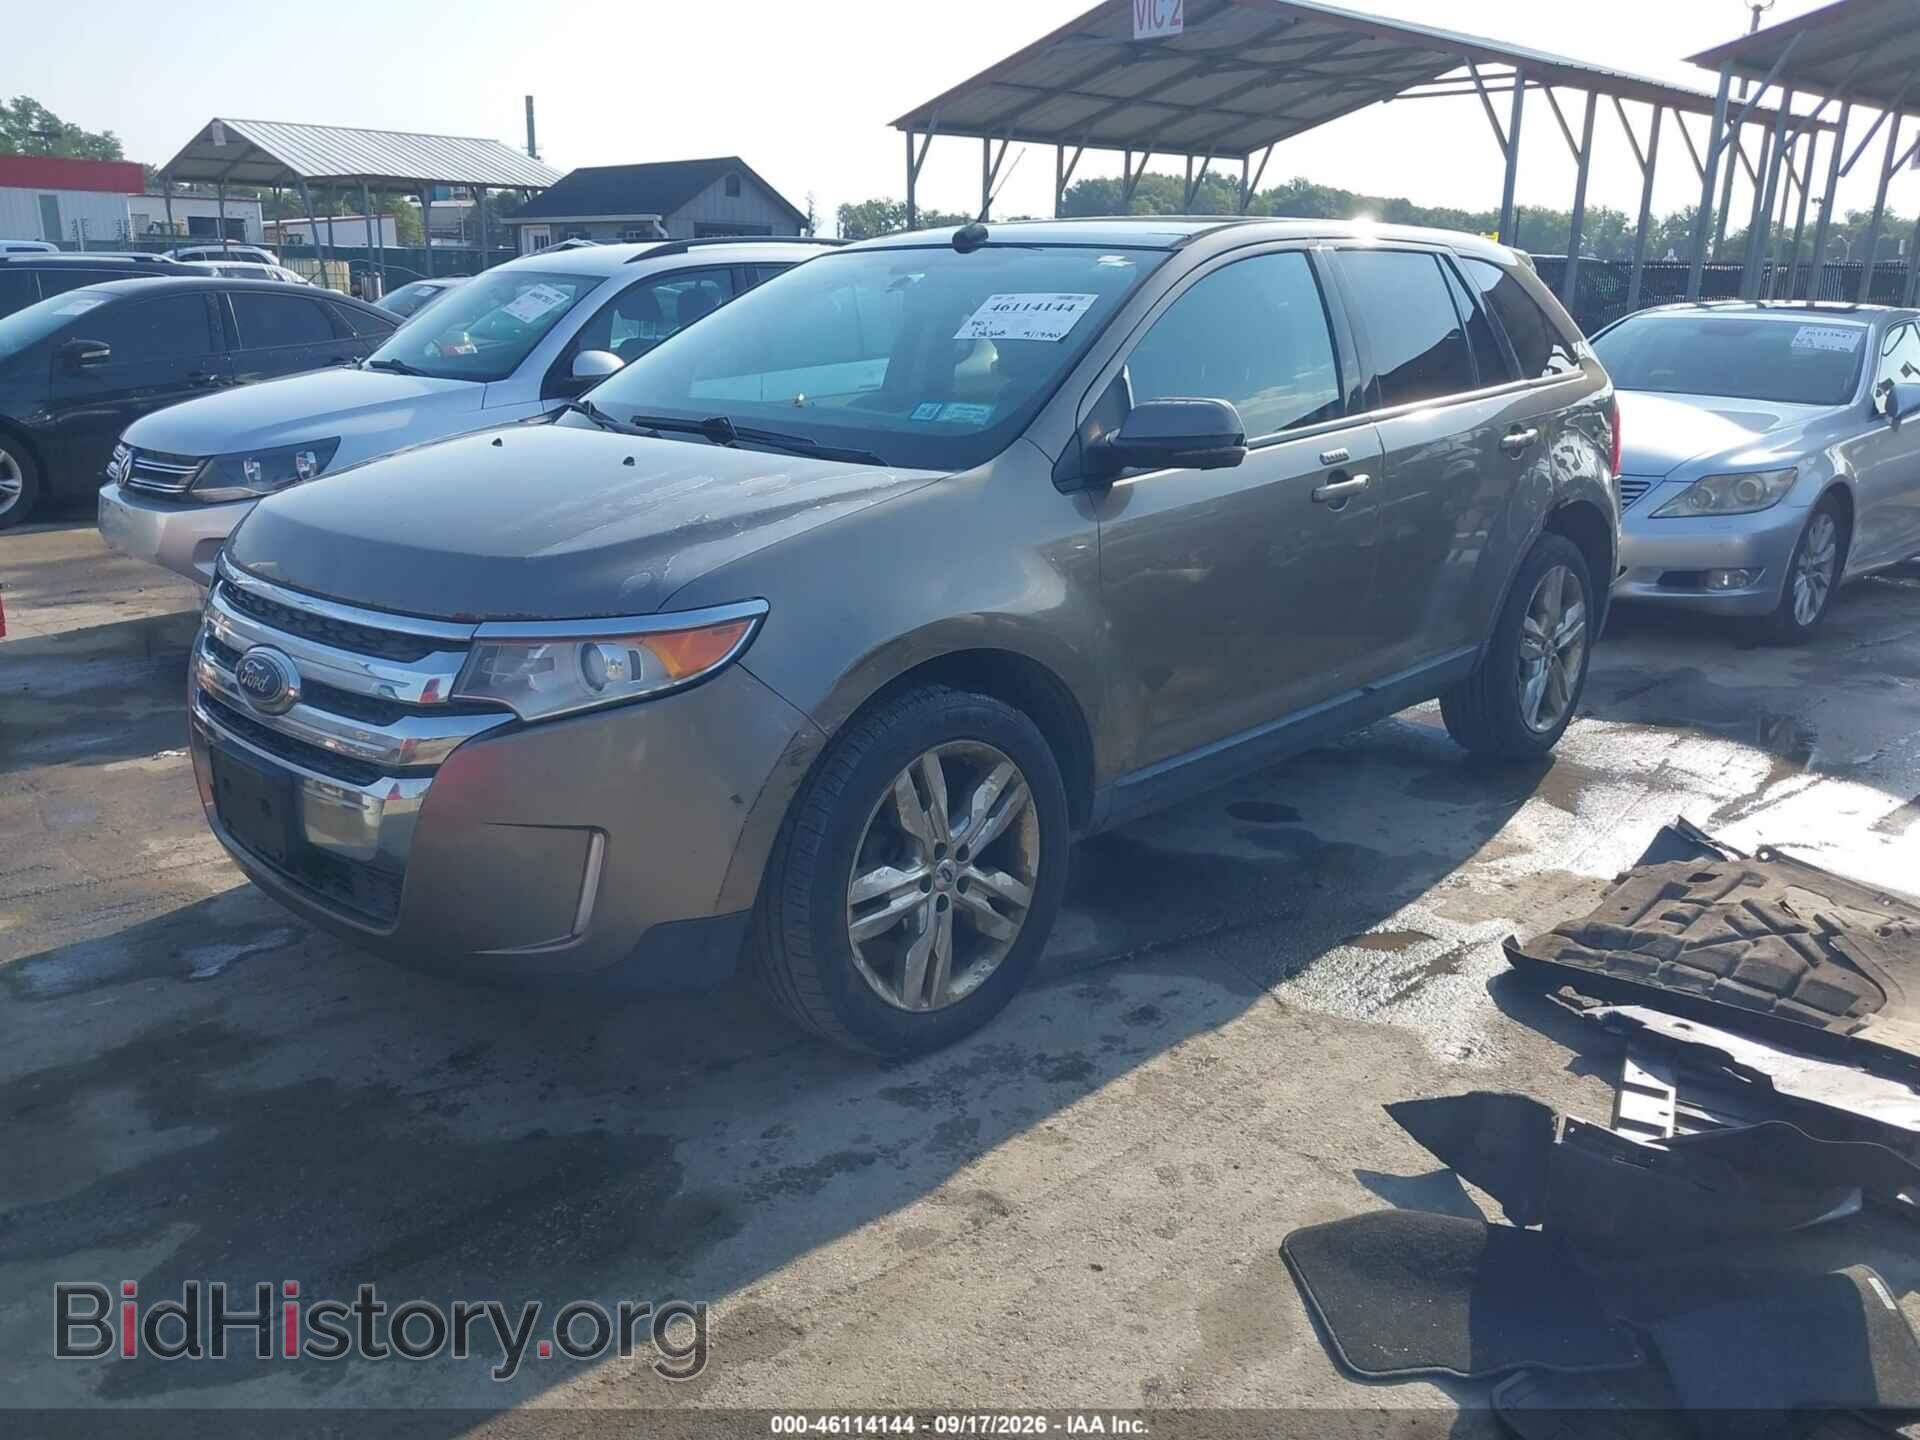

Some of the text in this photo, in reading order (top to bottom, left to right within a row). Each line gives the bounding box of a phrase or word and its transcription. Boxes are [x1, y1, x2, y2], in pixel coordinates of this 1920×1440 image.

[1136, 0, 1165, 31] VIC
[989, 302, 1077, 313] 46114144
[239, 659, 271, 693] Ford
